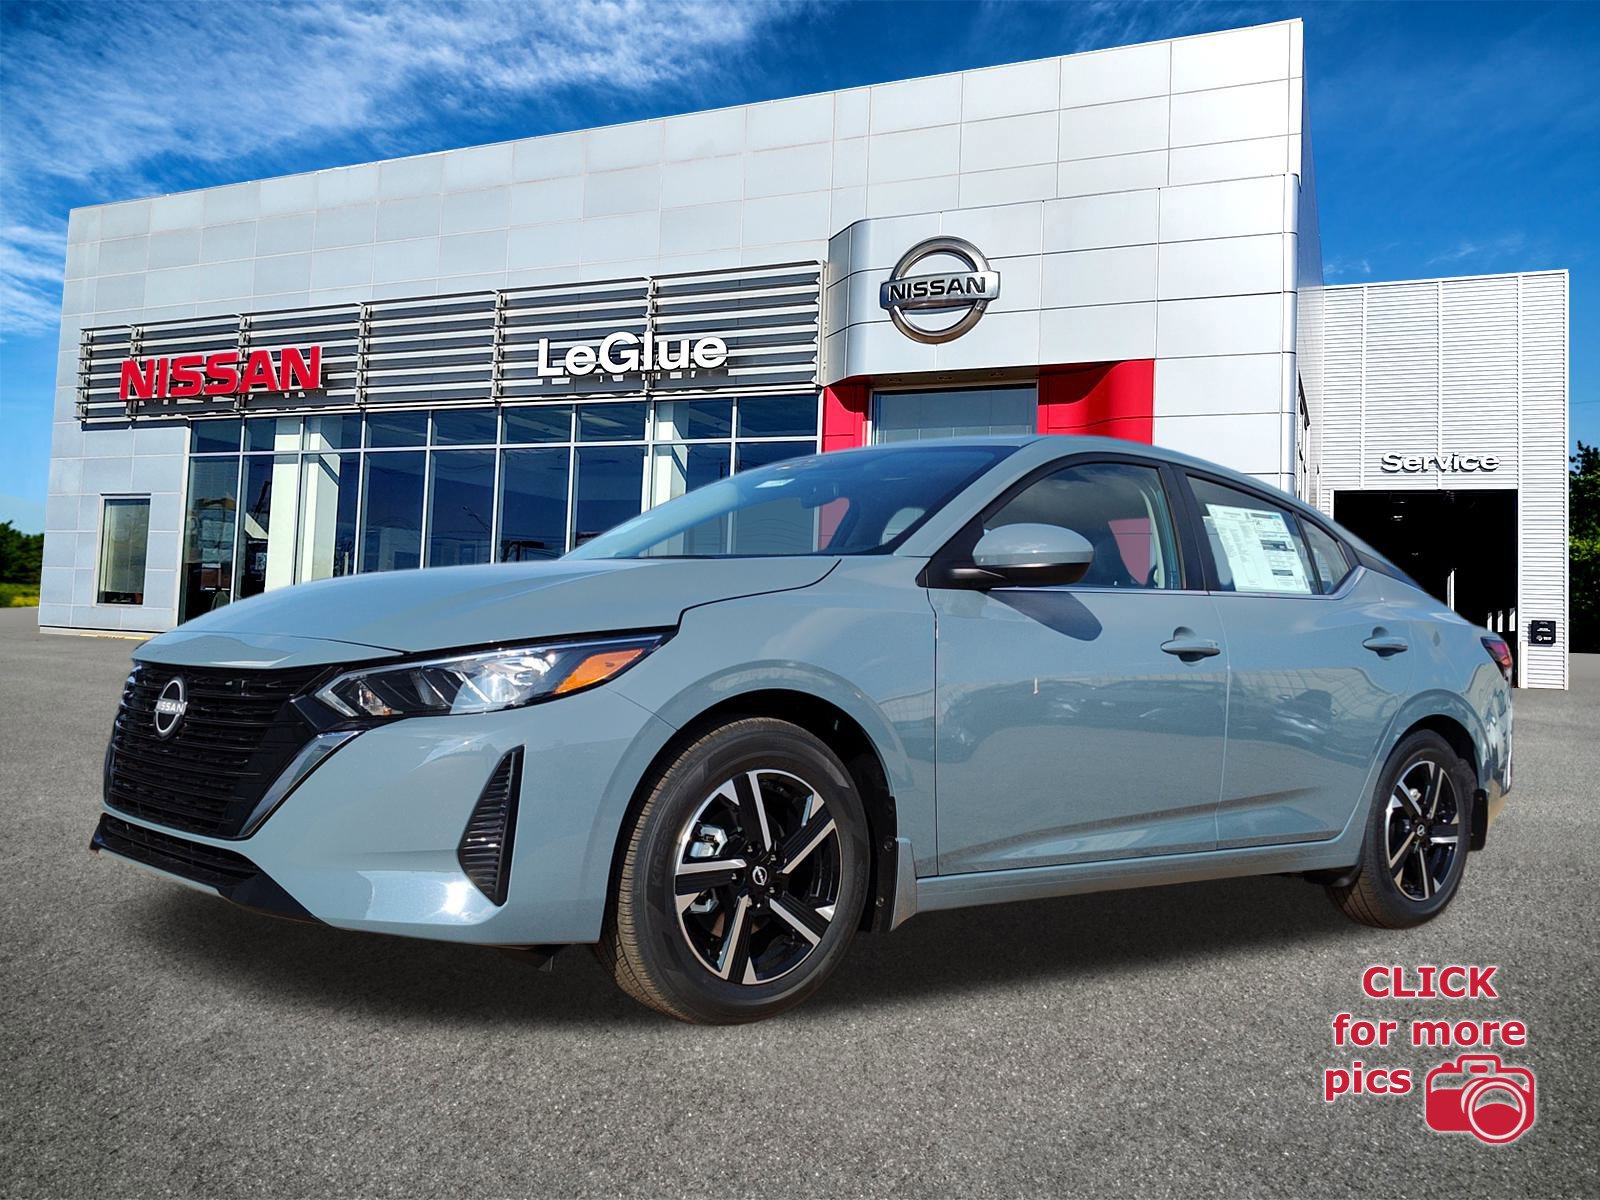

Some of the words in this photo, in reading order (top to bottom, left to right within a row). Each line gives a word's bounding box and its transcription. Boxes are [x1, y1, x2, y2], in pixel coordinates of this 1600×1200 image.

[888, 277, 985, 301] NISSAN
[537, 331, 728, 376] LeGlue
[119, 346, 322, 400] NISSAN
[1381, 451, 1499, 472] Service
